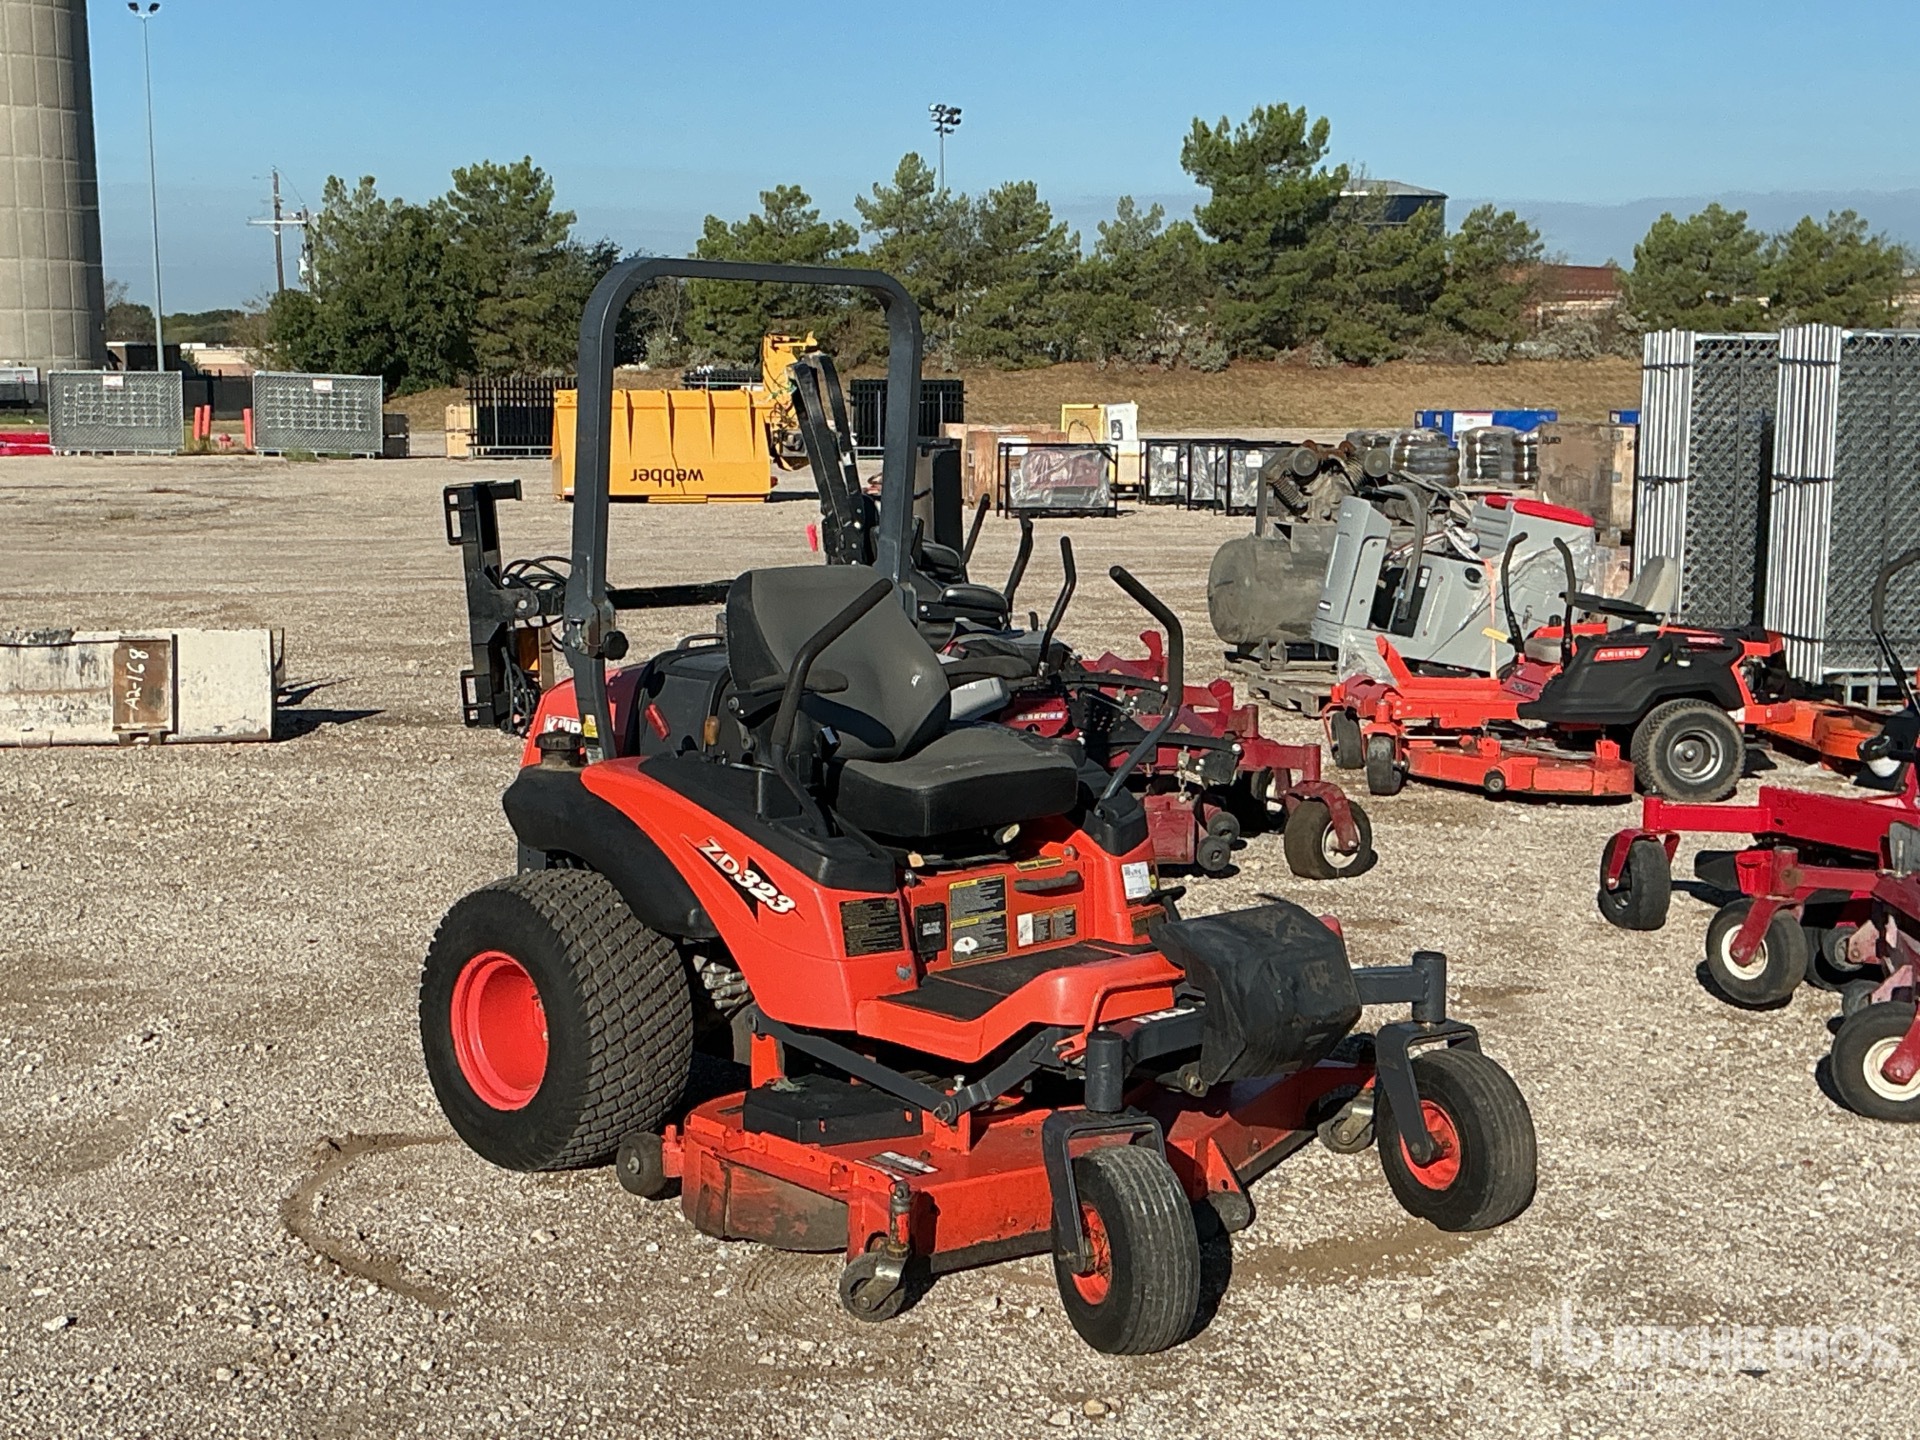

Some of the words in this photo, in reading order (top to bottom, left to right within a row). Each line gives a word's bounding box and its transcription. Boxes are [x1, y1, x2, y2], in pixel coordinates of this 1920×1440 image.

[630, 468, 704, 488] webber
[1600, 649, 1642, 659] ARIENS
[124, 648, 149, 711] A2-168
[543, 714, 583, 734] KUB
[699, 838, 796, 914] ZD323
